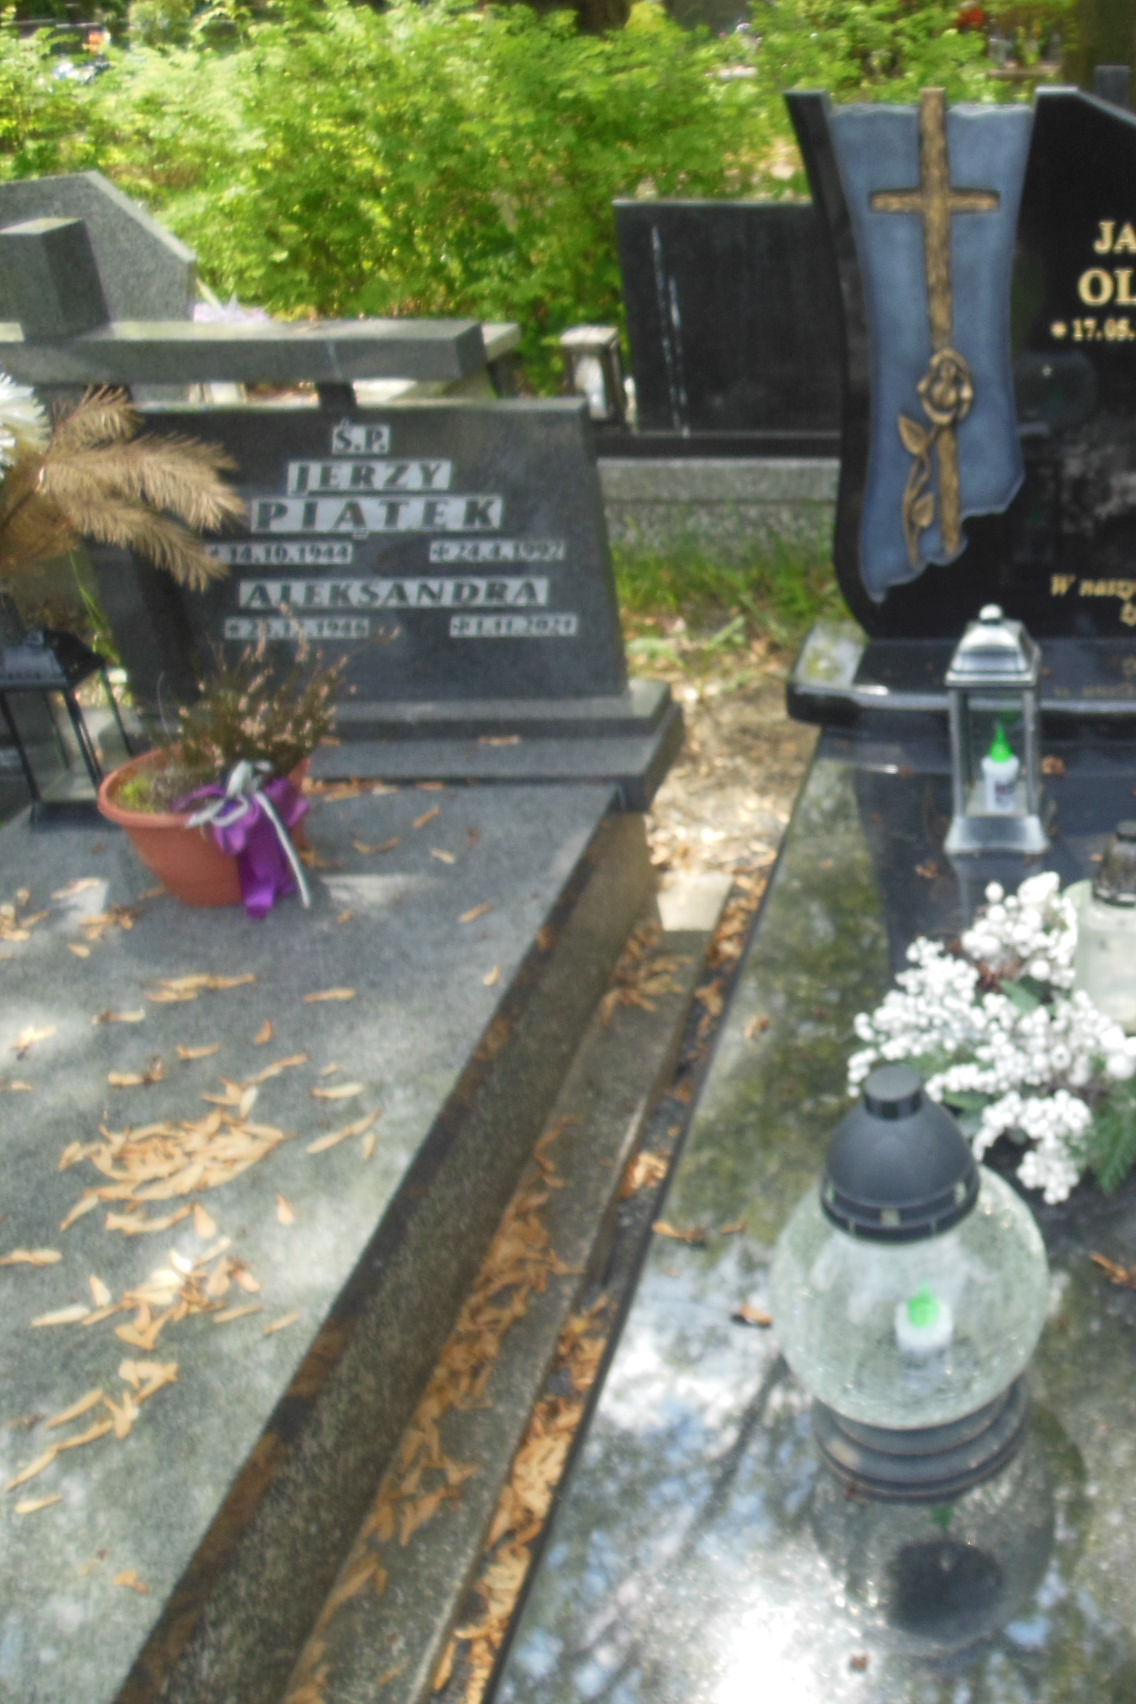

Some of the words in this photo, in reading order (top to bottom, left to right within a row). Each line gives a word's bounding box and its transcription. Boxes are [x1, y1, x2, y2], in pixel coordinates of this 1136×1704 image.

[334, 418, 387, 452] Ś.P.
[294, 463, 444, 495] JERZY
[245, 580, 539, 607] ALEKSANDRA
[1050, 574, 1076, 596] W
